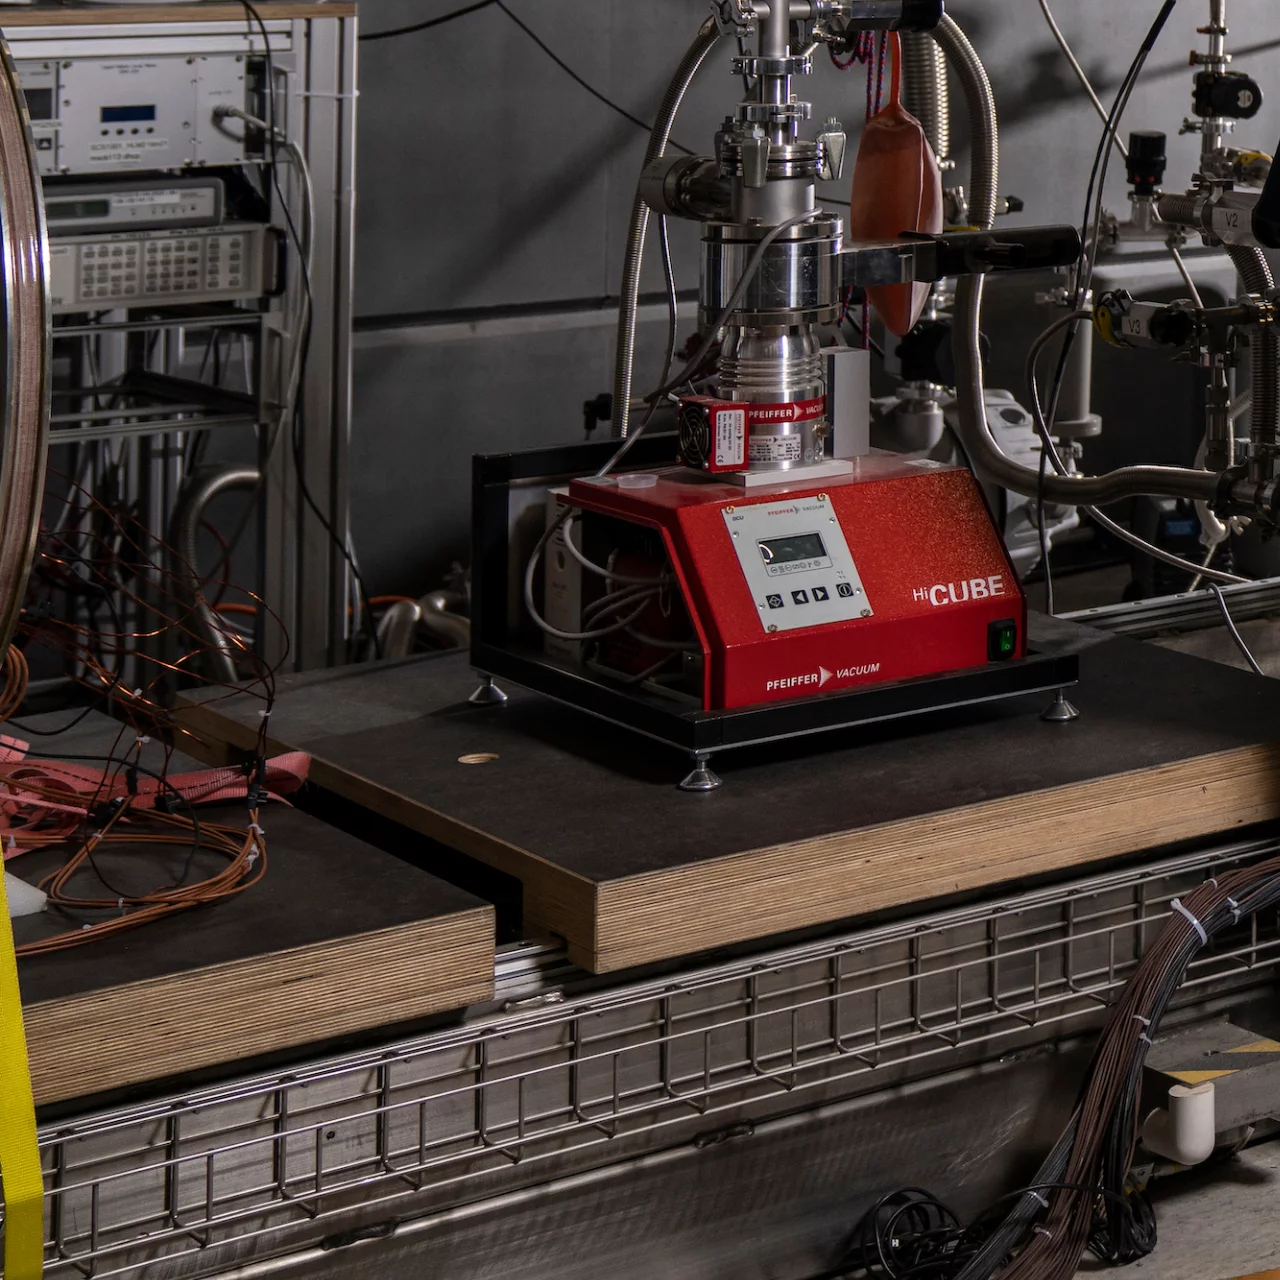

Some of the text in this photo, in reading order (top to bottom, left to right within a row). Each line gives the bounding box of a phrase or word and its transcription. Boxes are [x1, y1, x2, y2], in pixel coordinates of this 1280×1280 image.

[1225, 212, 1238, 228] V2
[1128, 319, 1141, 335] V3
[749, 409, 792, 419] PFEIFFER
[768, 508, 794, 516] PFEIFFER
[766, 663, 880, 691] PFEIFFER VACUUM
